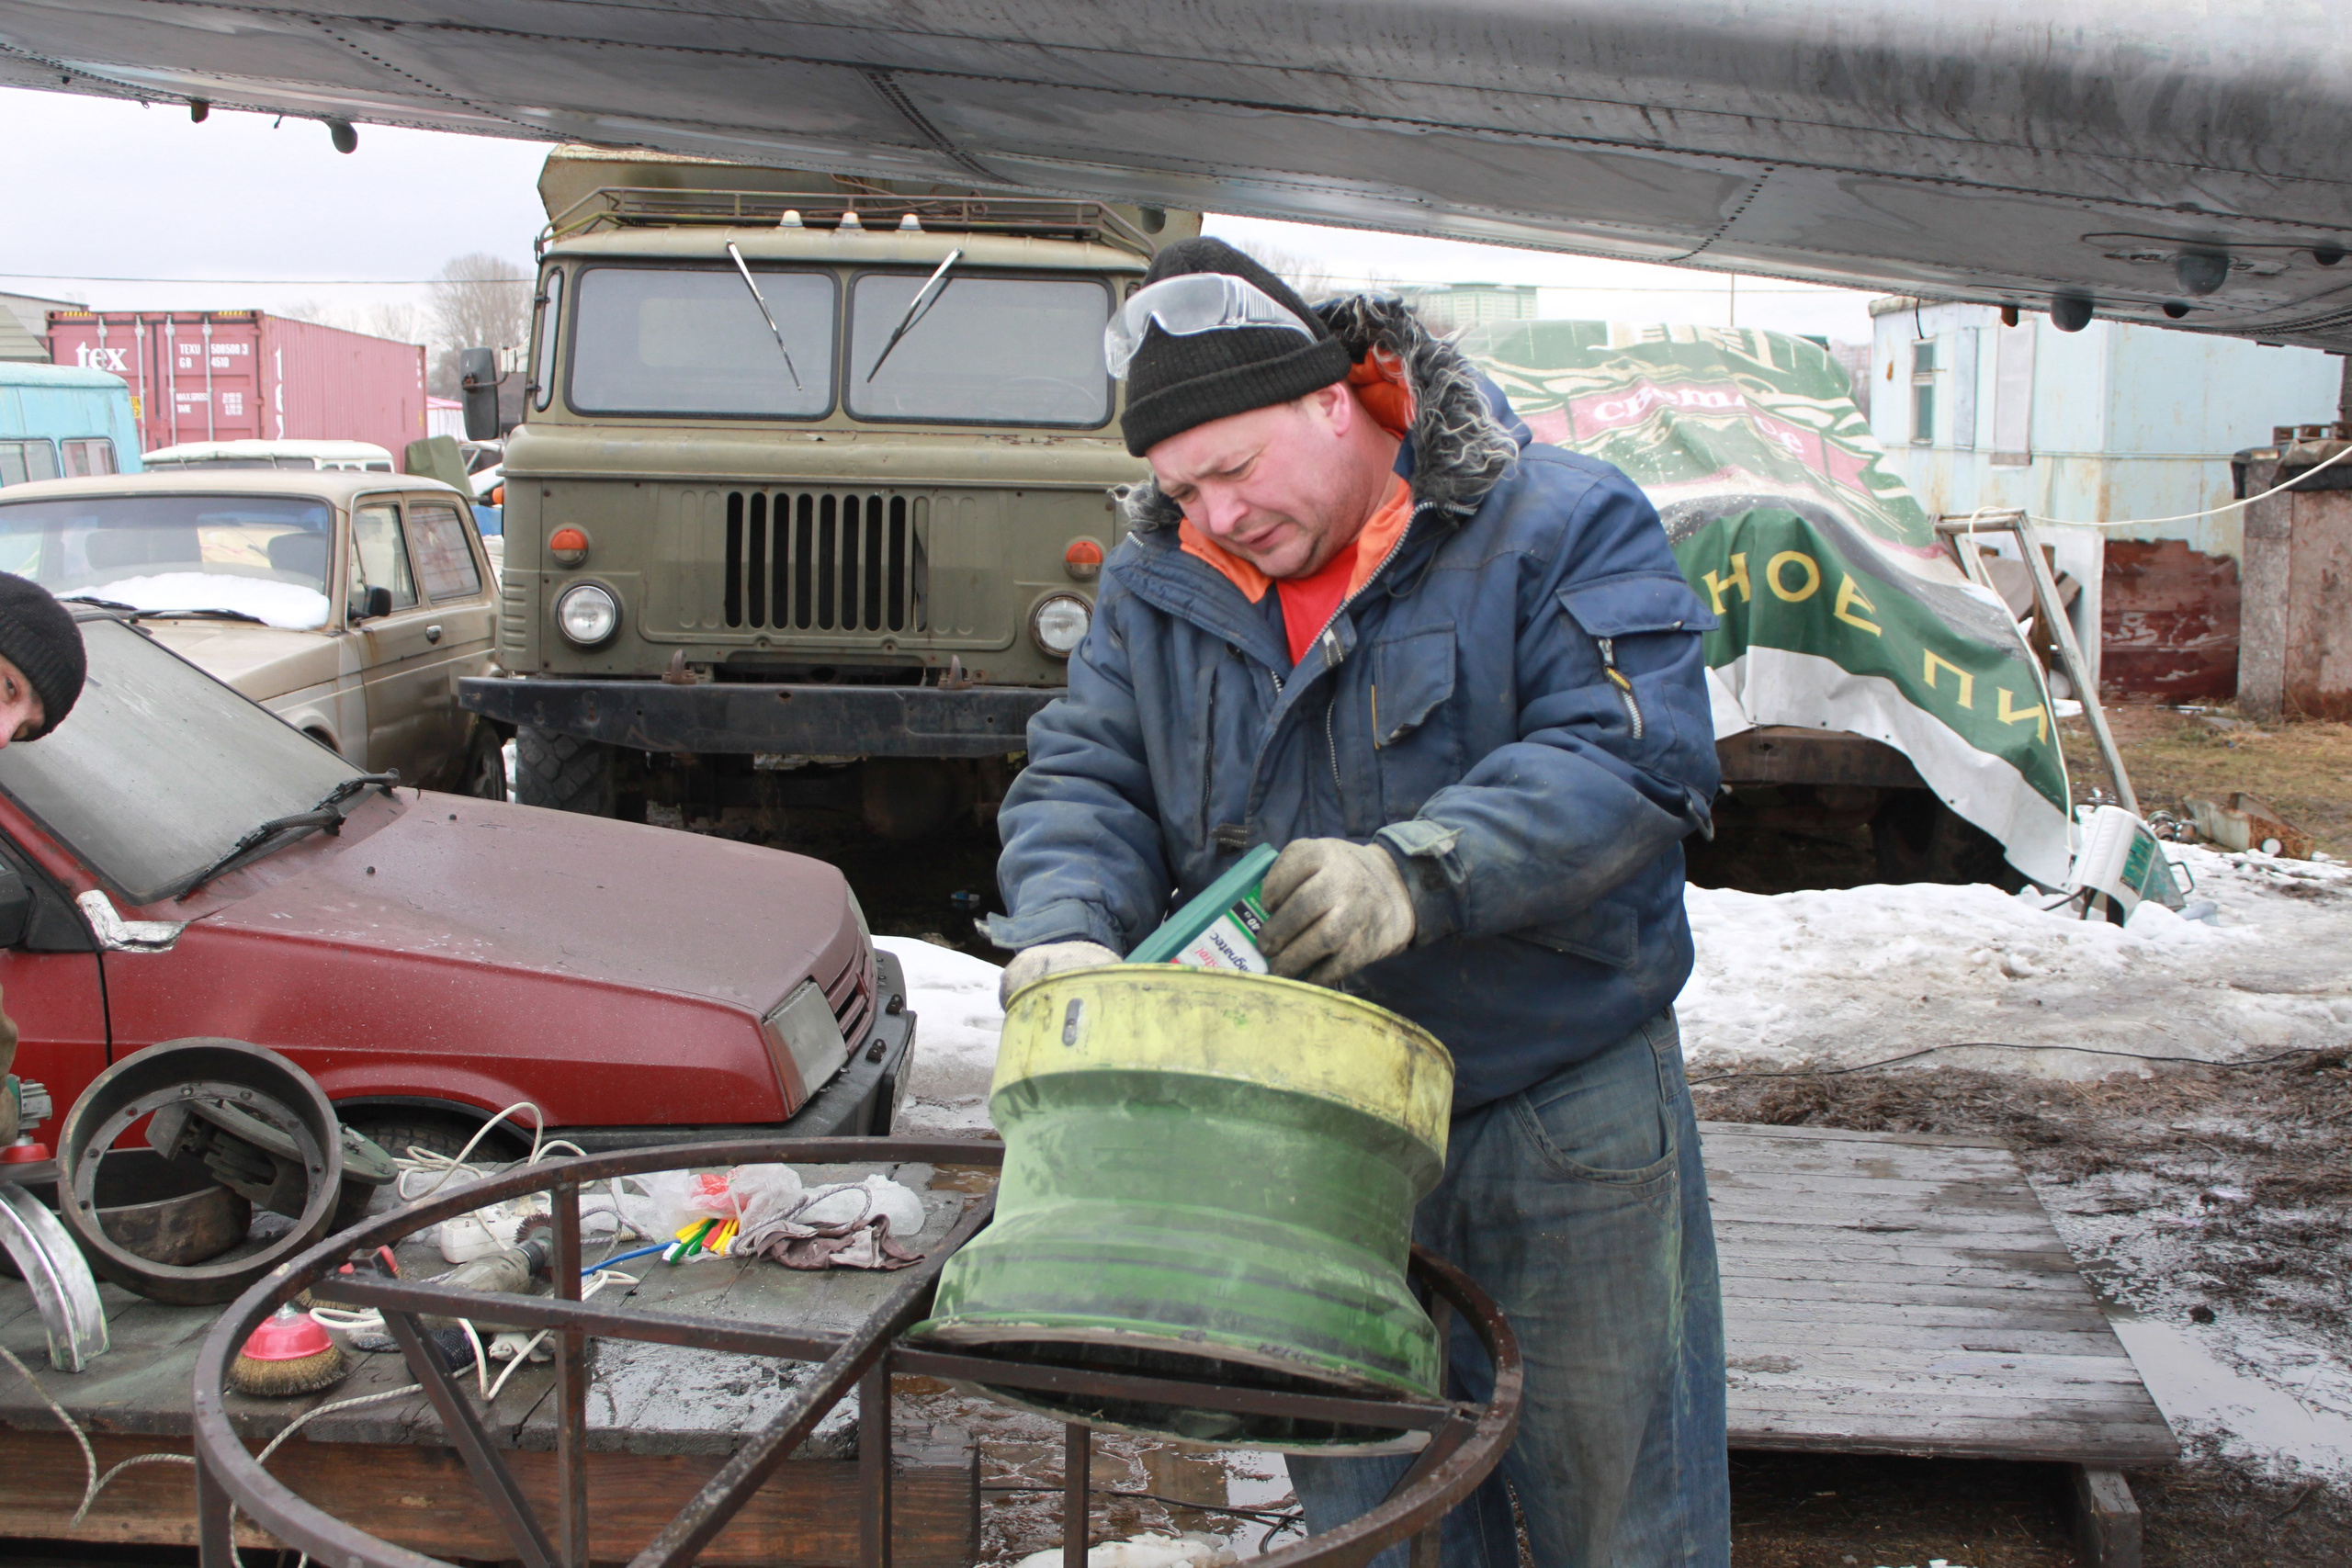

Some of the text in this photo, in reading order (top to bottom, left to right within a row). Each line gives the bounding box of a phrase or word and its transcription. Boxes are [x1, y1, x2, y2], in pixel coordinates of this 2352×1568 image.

[75, 341, 129, 372] tex
[179, 343, 201, 355] TEXU
[242, 343, 249, 356] 3
[210, 356, 230, 368] 4510
[1209, 931, 1250, 972] agnatec
